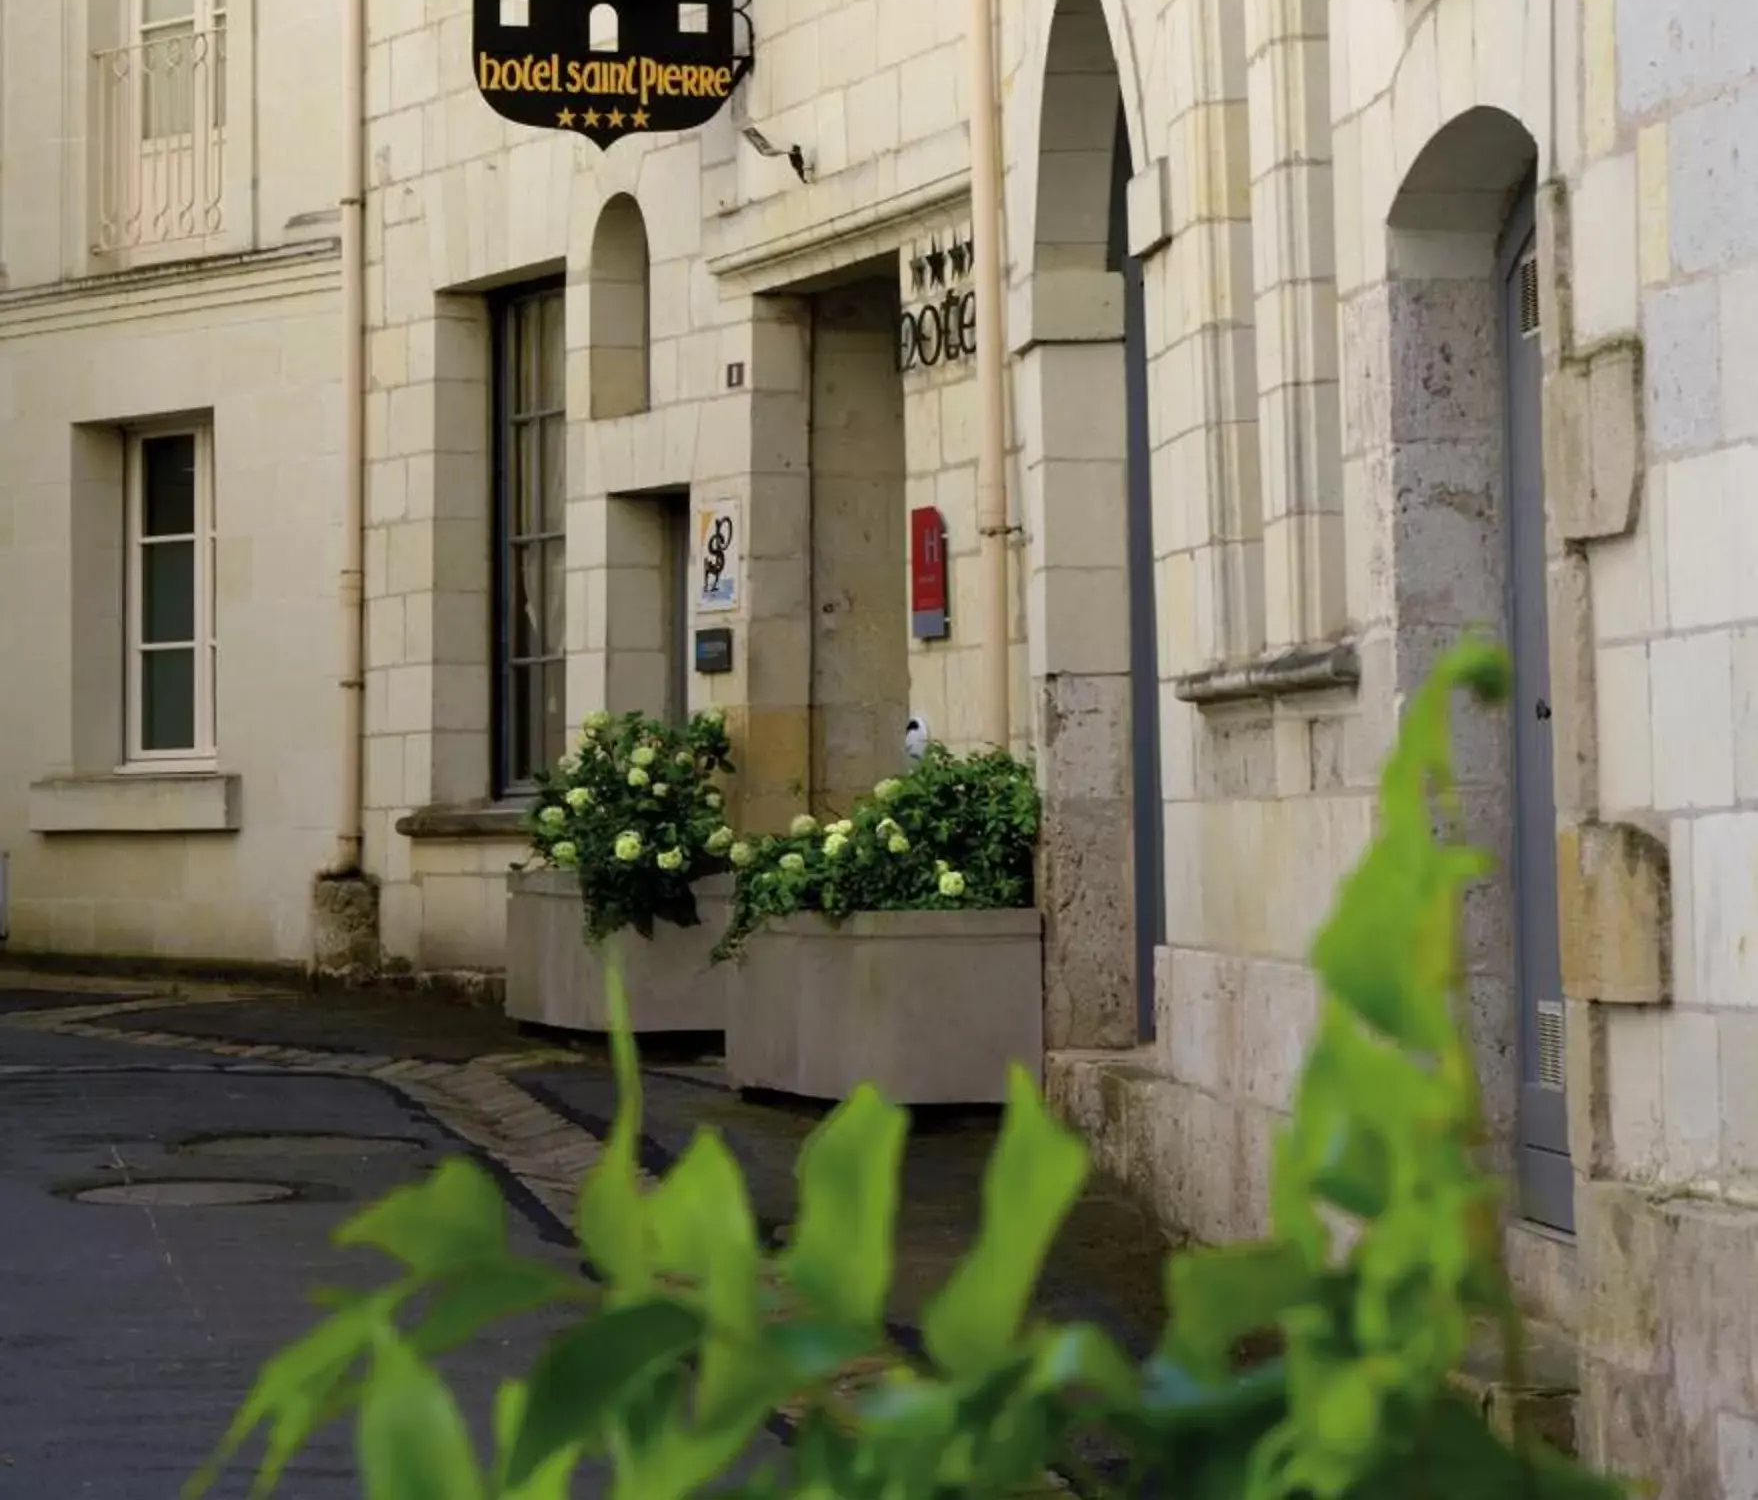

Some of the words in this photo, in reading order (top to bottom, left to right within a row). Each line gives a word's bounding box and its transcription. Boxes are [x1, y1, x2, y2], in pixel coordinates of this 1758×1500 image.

[480, 51, 562, 92] hotel
[566, 56, 638, 95] saint
[895, 288, 976, 372] hote
